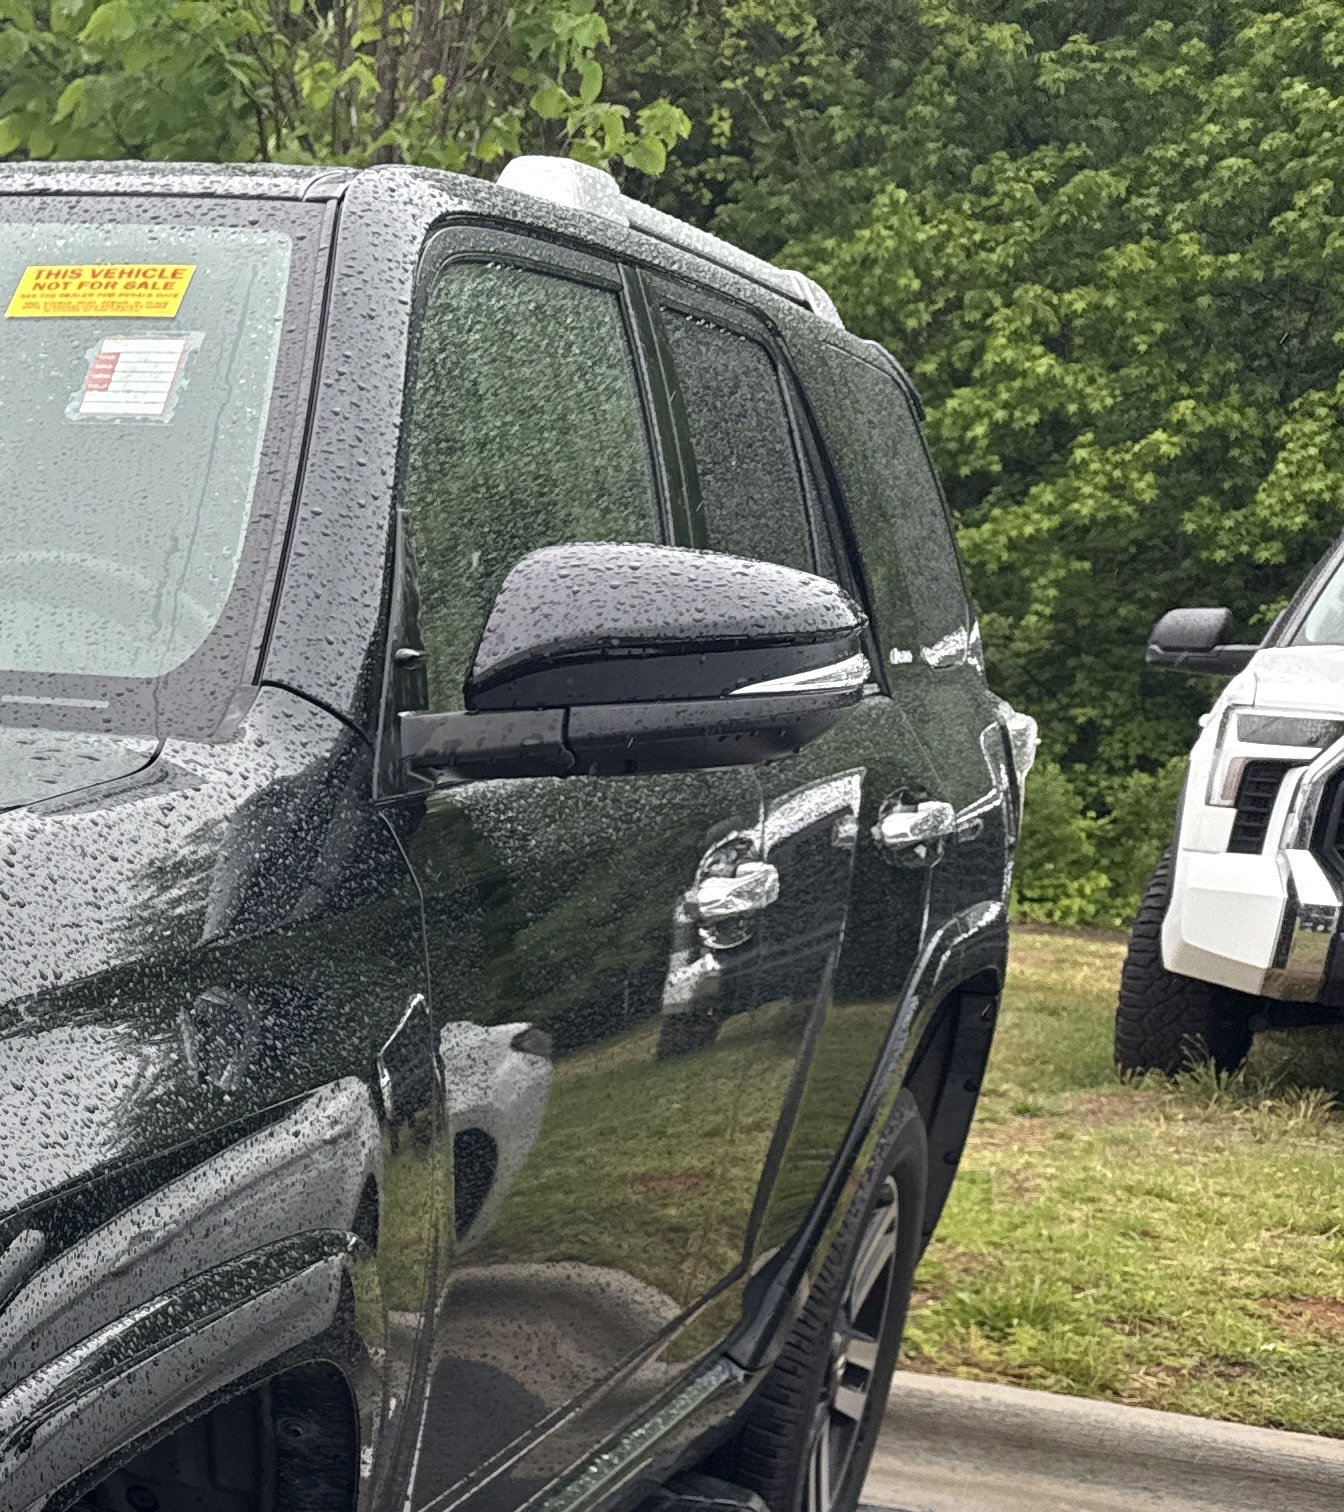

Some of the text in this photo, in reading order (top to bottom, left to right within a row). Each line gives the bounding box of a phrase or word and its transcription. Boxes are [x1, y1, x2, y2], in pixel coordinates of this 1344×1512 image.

[34, 267, 187, 280] THIS VEHICLE
[32, 281, 177, 291] NOT FOR SALE
